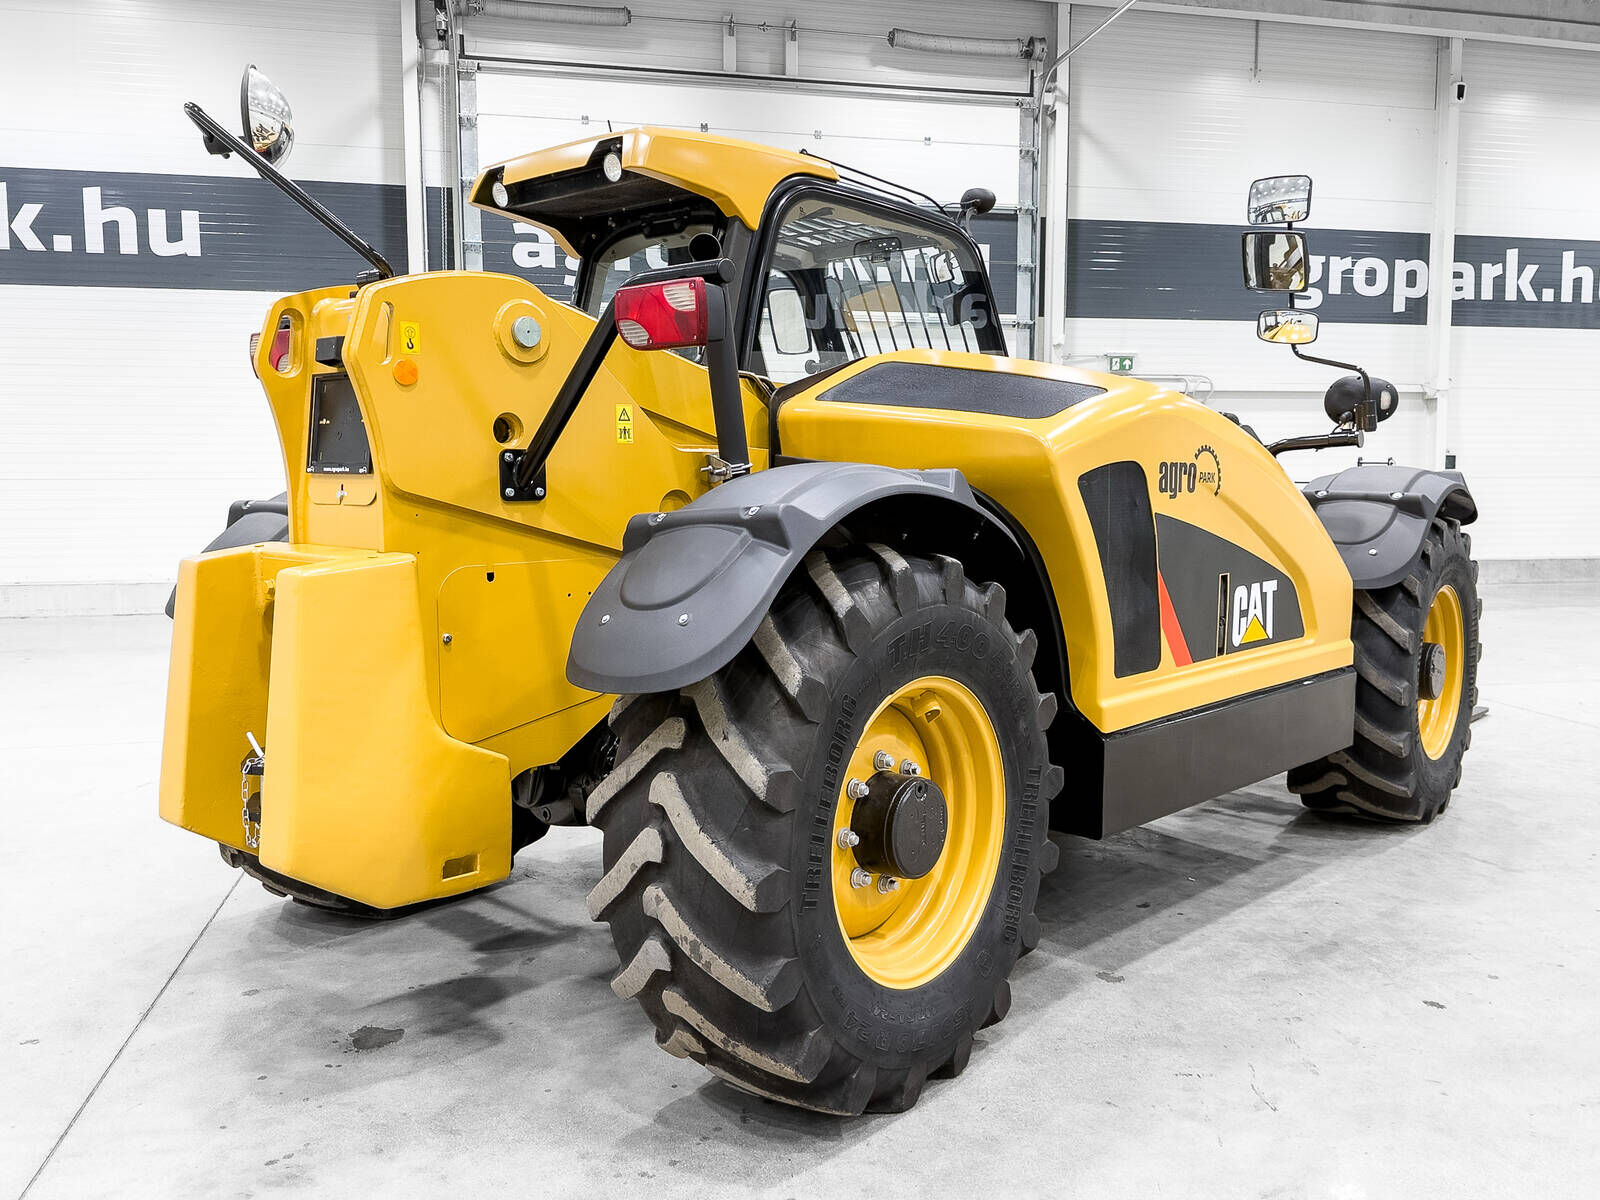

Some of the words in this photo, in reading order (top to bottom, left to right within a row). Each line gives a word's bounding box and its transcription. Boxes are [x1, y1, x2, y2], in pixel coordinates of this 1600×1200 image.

[1158, 461, 1197, 499] agro
[1198, 471, 1217, 484] PARK
[1232, 579, 1278, 648] CAT
[1003, 765, 1042, 946] TRELLEBORG
